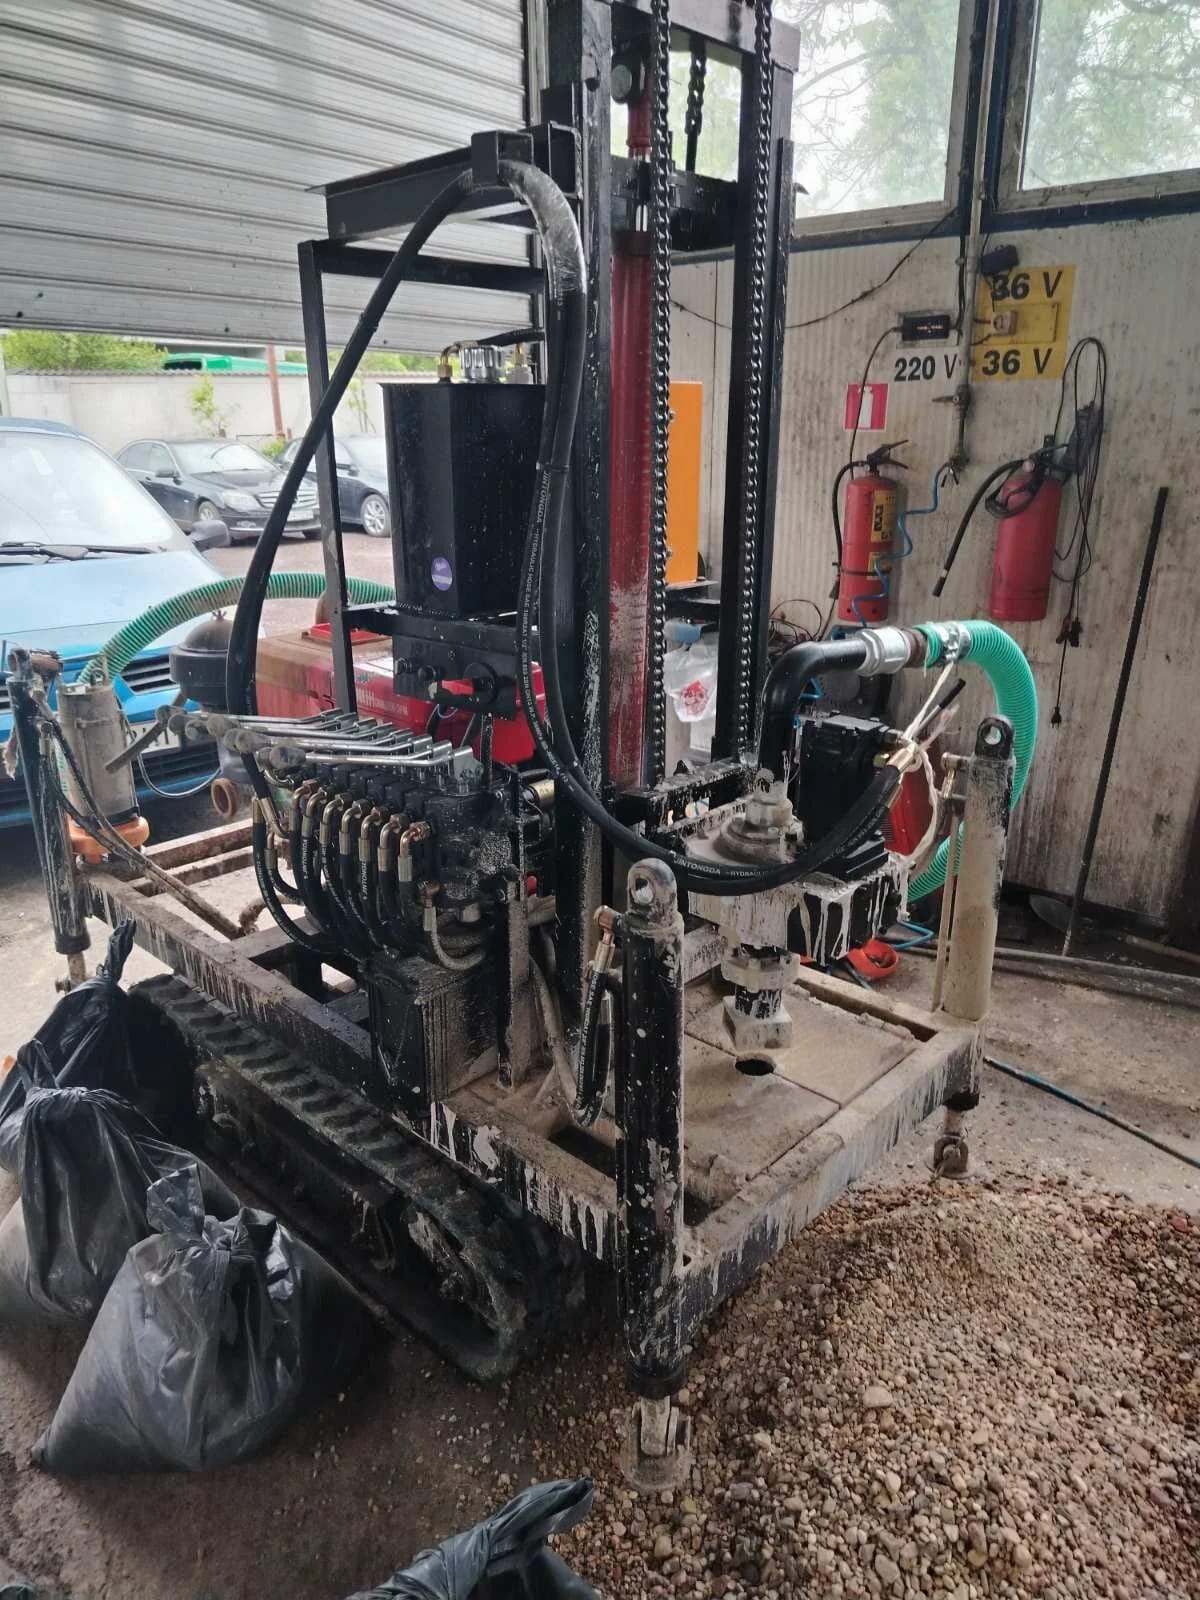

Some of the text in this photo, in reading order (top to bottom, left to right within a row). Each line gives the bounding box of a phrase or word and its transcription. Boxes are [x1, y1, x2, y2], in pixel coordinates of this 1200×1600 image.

[990, 271, 1063, 301] 36 V
[894, 354, 958, 382] 220 V
[982, 348, 1052, 376] 36 V
[536, 471, 551, 523] JINTONGDA
[673, 858, 721, 875] JINTONGDA
